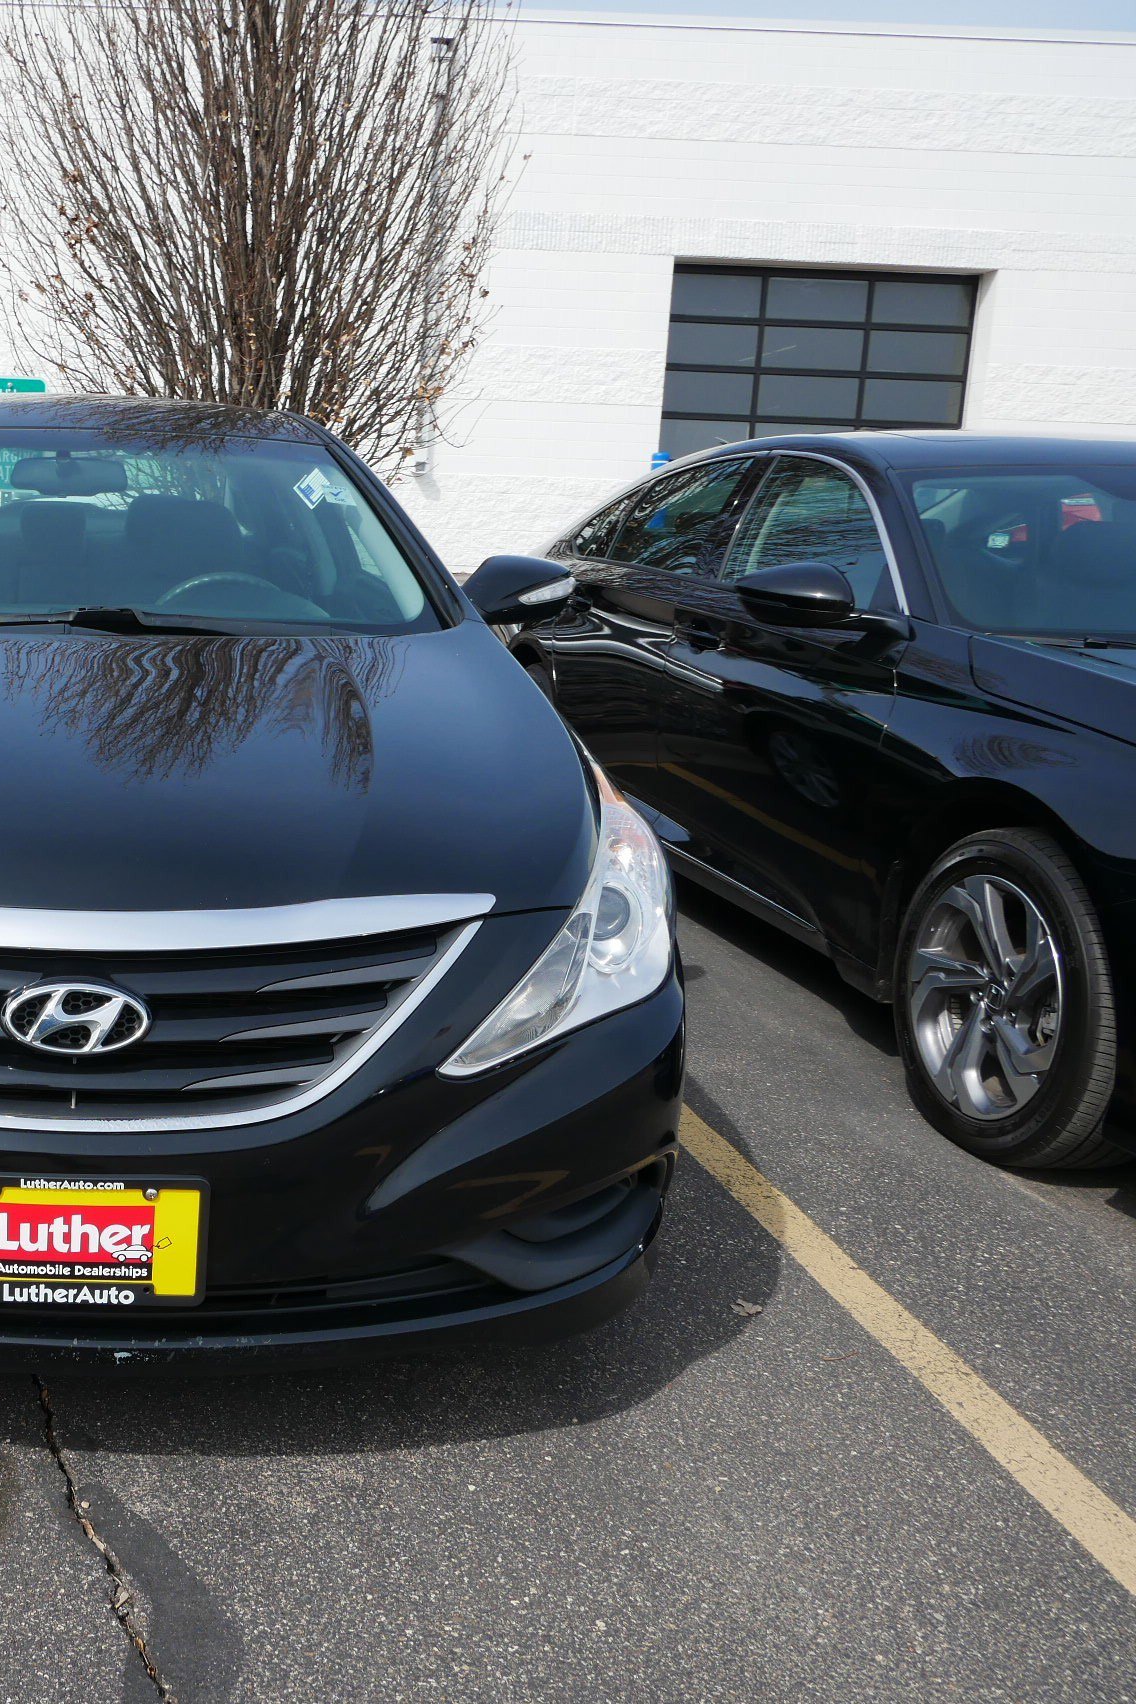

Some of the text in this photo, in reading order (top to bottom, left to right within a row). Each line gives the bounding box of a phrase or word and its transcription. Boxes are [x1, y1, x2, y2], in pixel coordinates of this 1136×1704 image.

[20, 1178, 125, 1190] LutherAuto.com
[74, 1265, 148, 1278] Dealerships
[3, 1283, 135, 1305] LutherAuto
